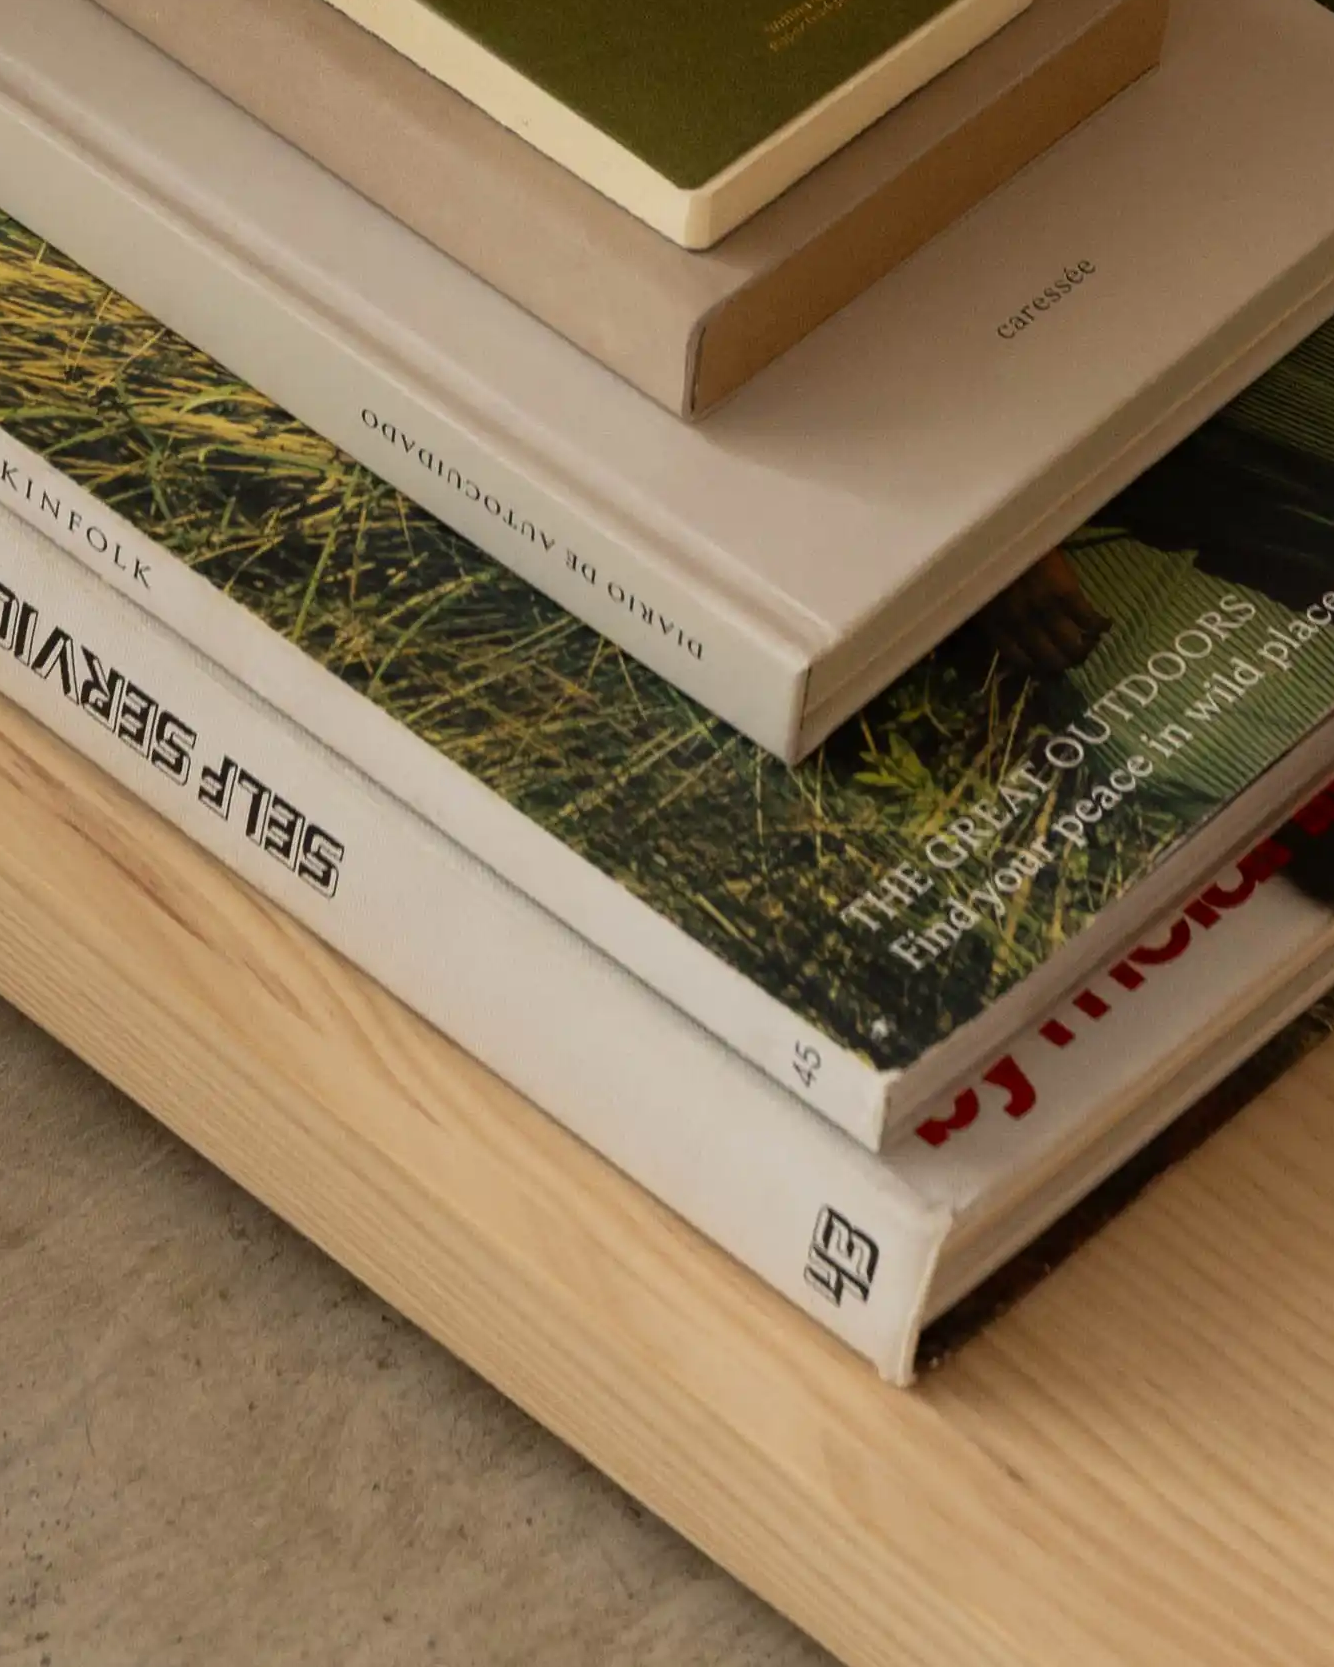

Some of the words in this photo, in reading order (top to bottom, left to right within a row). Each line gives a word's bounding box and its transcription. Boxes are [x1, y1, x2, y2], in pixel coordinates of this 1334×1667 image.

[996, 256, 1097, 340] caressée
[360, 407, 556, 552] AUTOCUIDADO
[566, 549, 598, 586] DE
[607, 581, 705, 662] DIARIO
[840, 859, 935, 938] THE
[926, 757, 1057, 871] GREAT
[1044, 590, 1259, 772] OUTDOORS
[889, 897, 979, 972] Find
[970, 838, 1055, 920] your
[1053, 756, 1155, 851] peace
[1147, 724, 1193, 762] in
[1189, 659, 1267, 724] wild
[197, 755, 345, 900] SELF
[792, 1038, 822, 1090] 45
